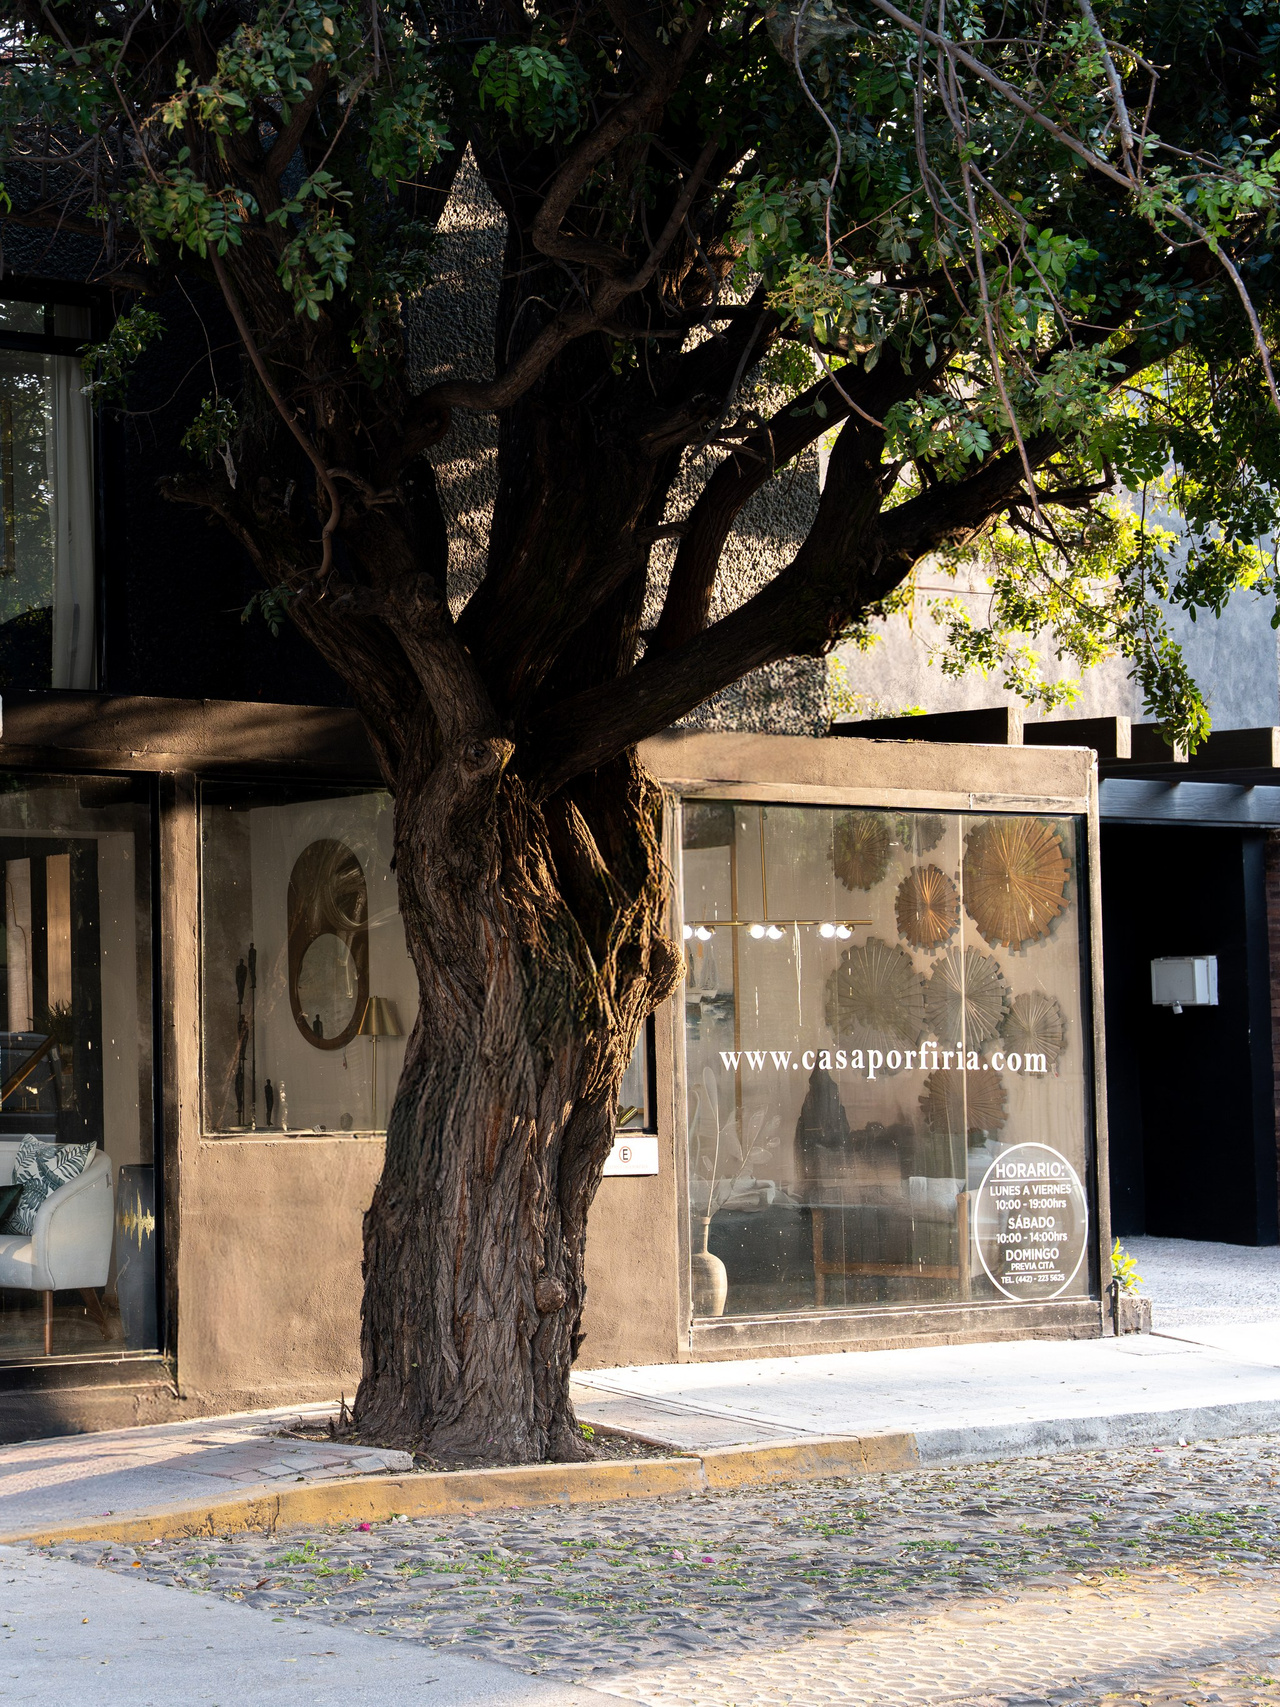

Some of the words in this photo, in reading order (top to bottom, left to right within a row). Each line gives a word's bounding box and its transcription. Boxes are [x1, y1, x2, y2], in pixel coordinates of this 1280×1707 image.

[719, 1041, 1048, 1079] www.casaporfiria.com
[995, 1162, 1066, 1179] HORARIO:
[989, 1185, 1021, 1197] LUNES
[1022, 1185, 1031, 1196] A
[1031, 1183, 1072, 1195] VIERNES
[995, 1199, 1022, 1210] 10:00
[1028, 1198, 1067, 1209] 19:00hrs
[1008, 1214, 1056, 1230] SÁBADO
[996, 1233, 1022, 1244] 10:00
[1029, 1231, 1068, 1242] 14:00hrs
[1005, 1247, 1060, 1262] DOMINGO
[1010, 1262, 1038, 1271] PREVIA
[1038, 1261, 1055, 1270] CITA
[1000, 1276, 1015, 1284] TEL.
